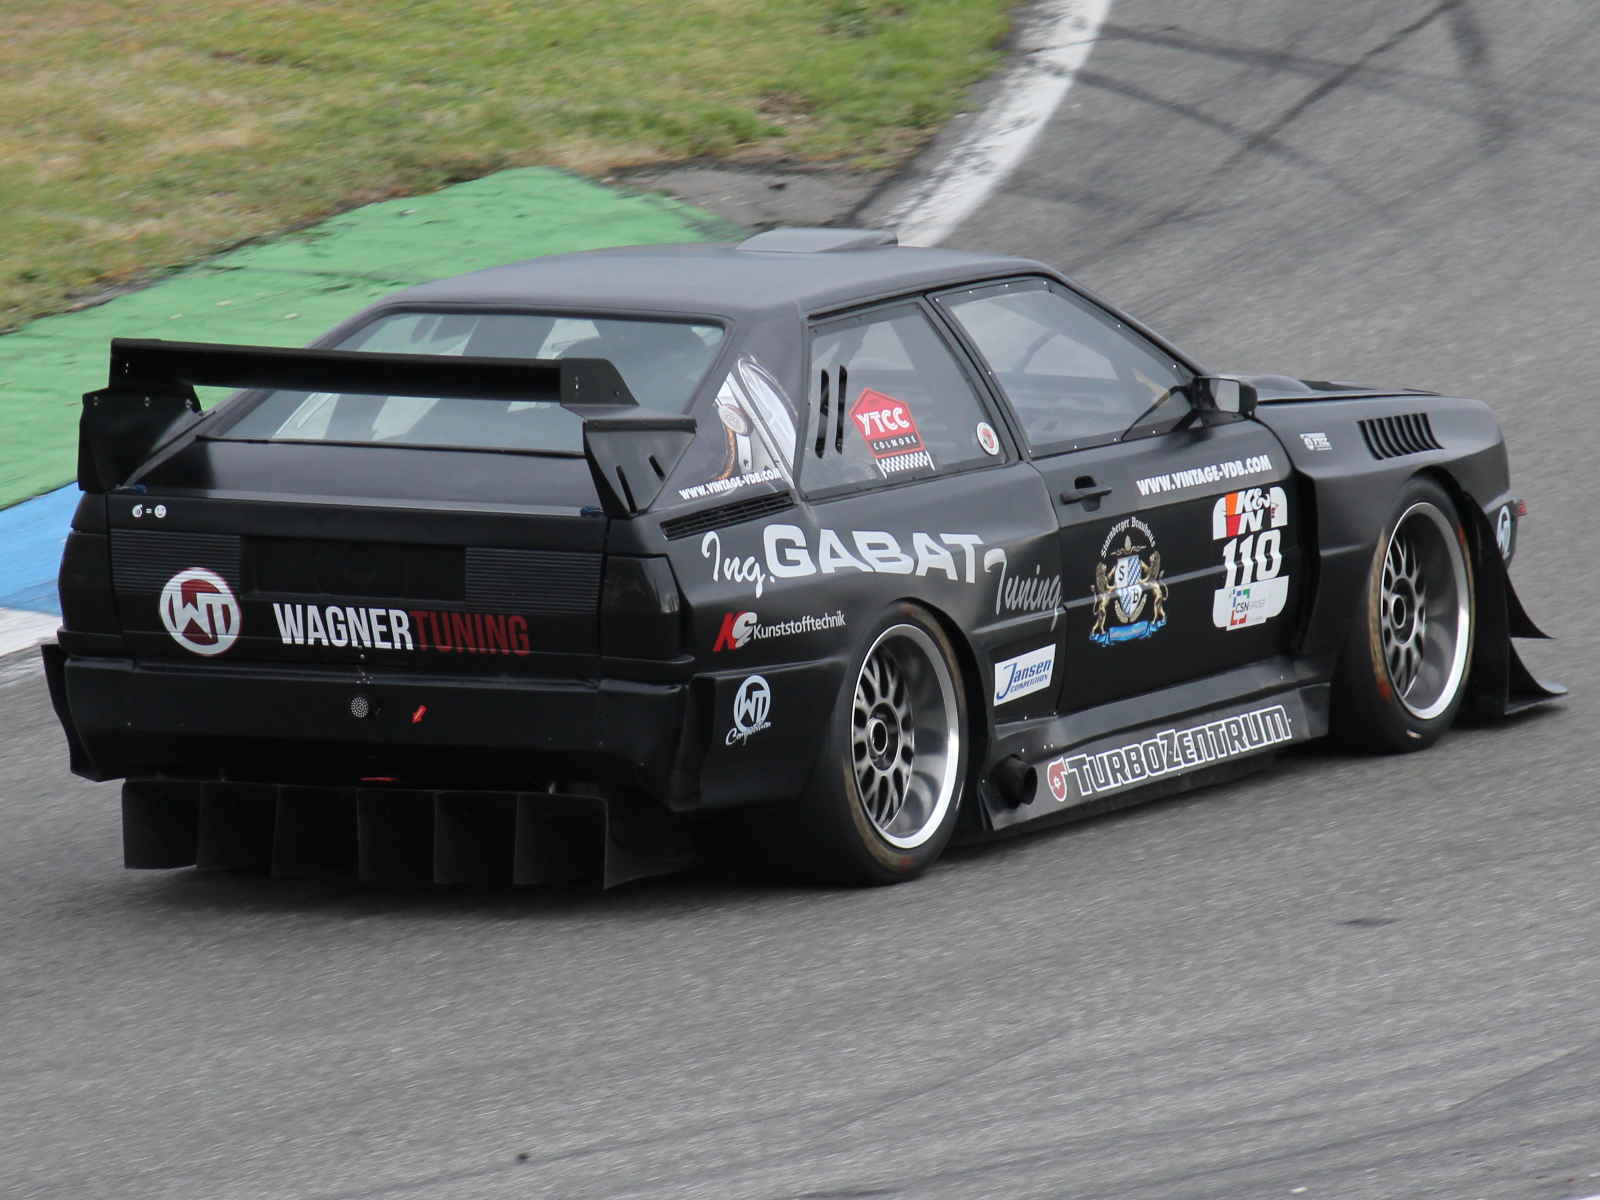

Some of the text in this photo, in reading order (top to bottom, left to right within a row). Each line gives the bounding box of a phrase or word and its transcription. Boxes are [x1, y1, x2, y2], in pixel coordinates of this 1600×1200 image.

[856, 406, 910, 436] YTCC
[873, 435, 917, 450] COLMORE
[678, 467, 783, 500] WWW.VINTAGE-VDB.COM
[1136, 454, 1272, 496] WWW.VINTAGE-VDB.COM
[1222, 529, 1283, 589] 110
[762, 523, 985, 584] GABAT
[983, 548, 1062, 632] Tuning
[753, 609, 846, 640] Kunststofftechnik
[996, 659, 1053, 700] Jansen
[1010, 674, 1049, 693] COMPETITION
